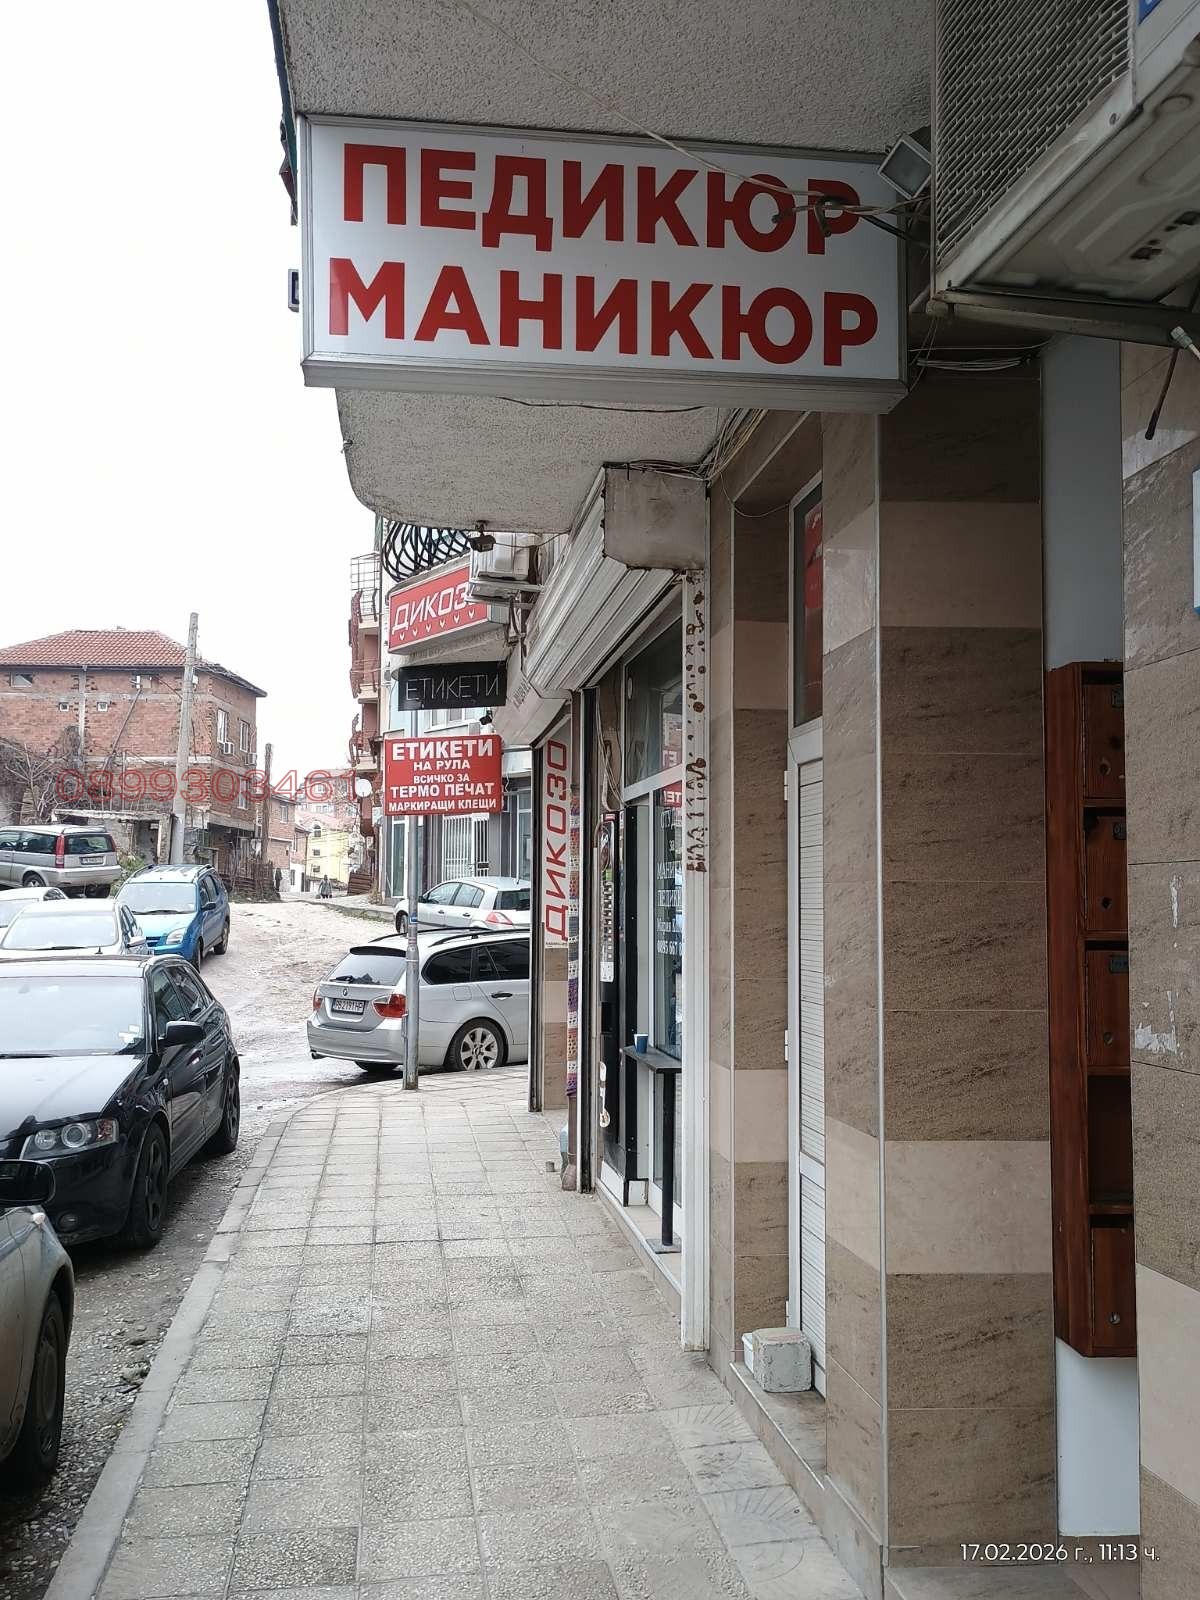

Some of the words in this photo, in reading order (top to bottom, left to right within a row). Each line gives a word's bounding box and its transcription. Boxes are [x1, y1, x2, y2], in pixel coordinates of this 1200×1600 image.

[342, 143, 861, 256] ПЕДИКЮР
[329, 257, 878, 366] МАНИКЮР
[391, 581, 476, 635] ДИКОЗ
[406, 674, 499, 701] ЕТИКЕТИ
[392, 738, 493, 761] ЕТИКЕТИ
[413, 761, 432, 771] НА
[436, 759, 471, 770] РУЛА
[390, 784, 440, 799] ТЕРМО
[444, 782, 495, 797] ПЕЧАТ
[413, 774, 455, 784] ВСИЧКО
[457, 773, 470, 782] ЗА
[388, 800, 455, 812] МАРКИРАЩИ
[458, 798, 497, 810] КЛЕЩИ
[545, 740, 569, 942] ДИКОЗО
